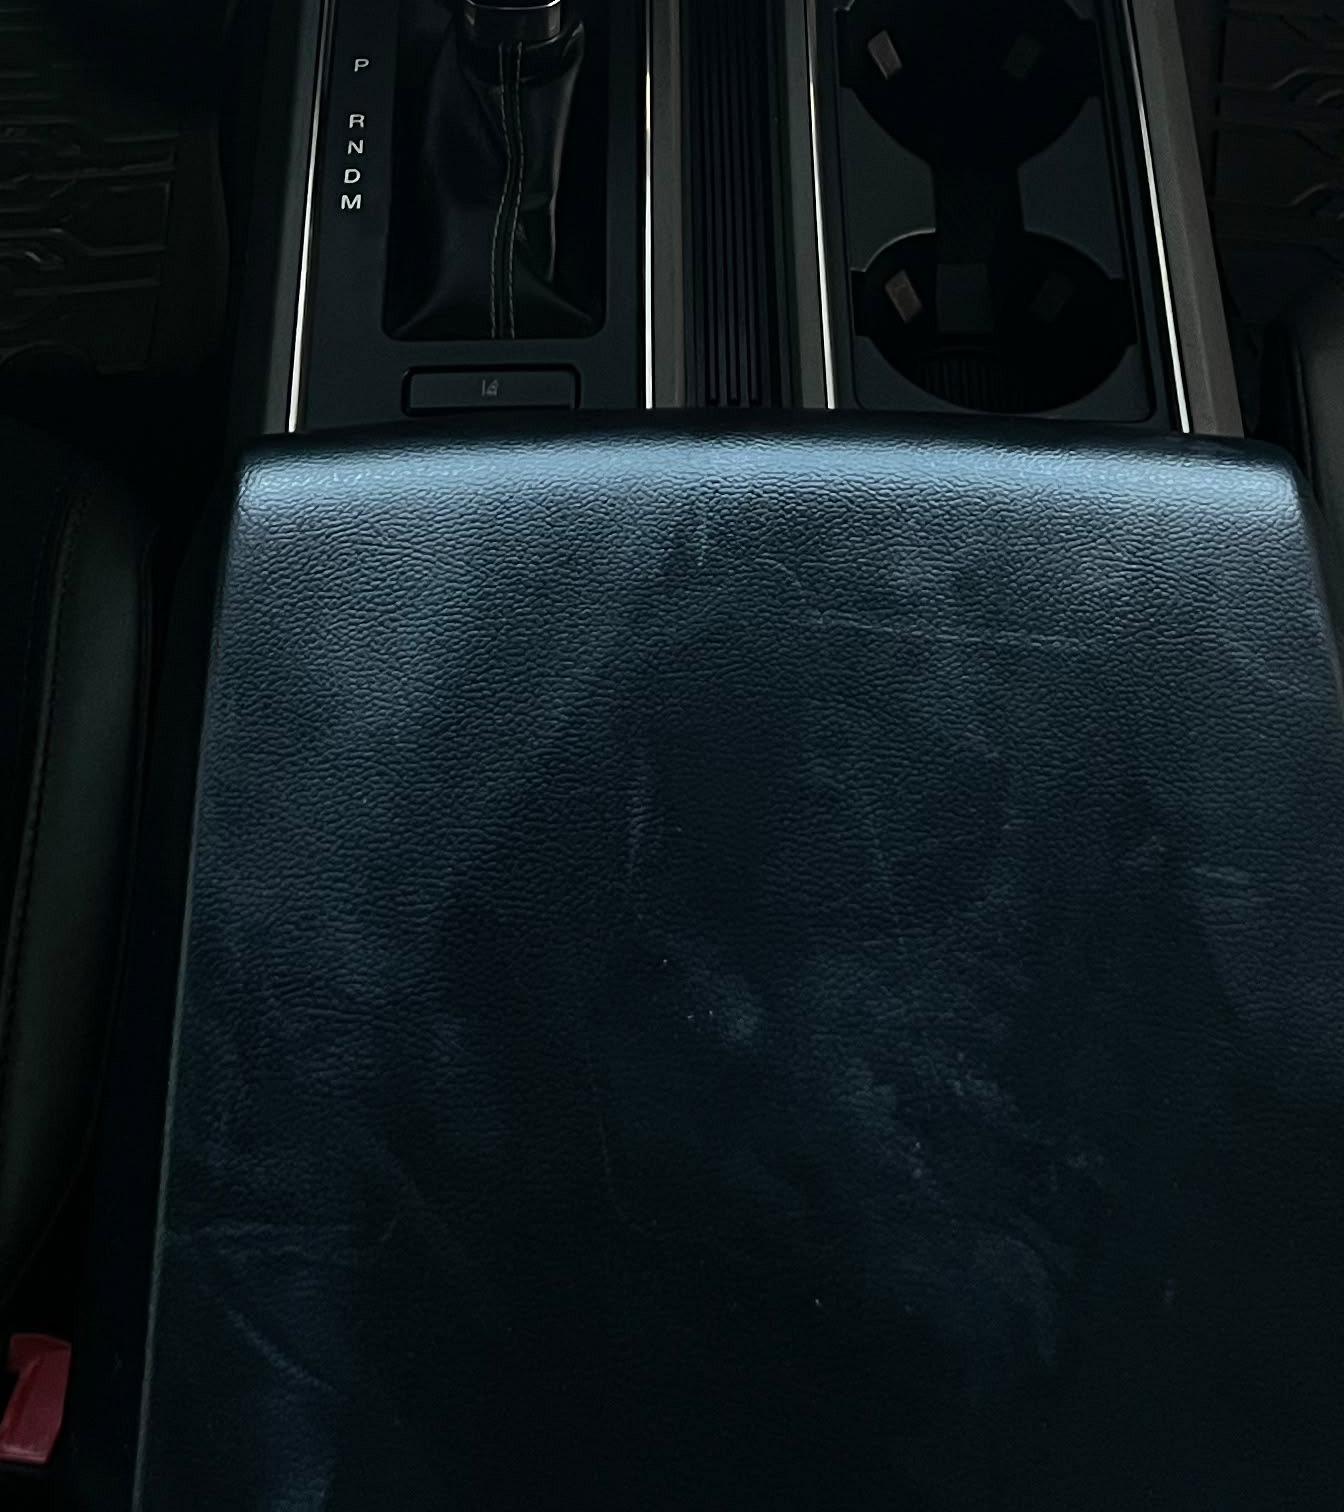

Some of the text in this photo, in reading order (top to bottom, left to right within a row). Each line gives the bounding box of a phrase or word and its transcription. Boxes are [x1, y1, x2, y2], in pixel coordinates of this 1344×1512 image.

[353, 58, 370, 72] P
[348, 114, 365, 128] R
[347, 139, 364, 155] N
[343, 168, 361, 184] D
[340, 194, 362, 210] M
